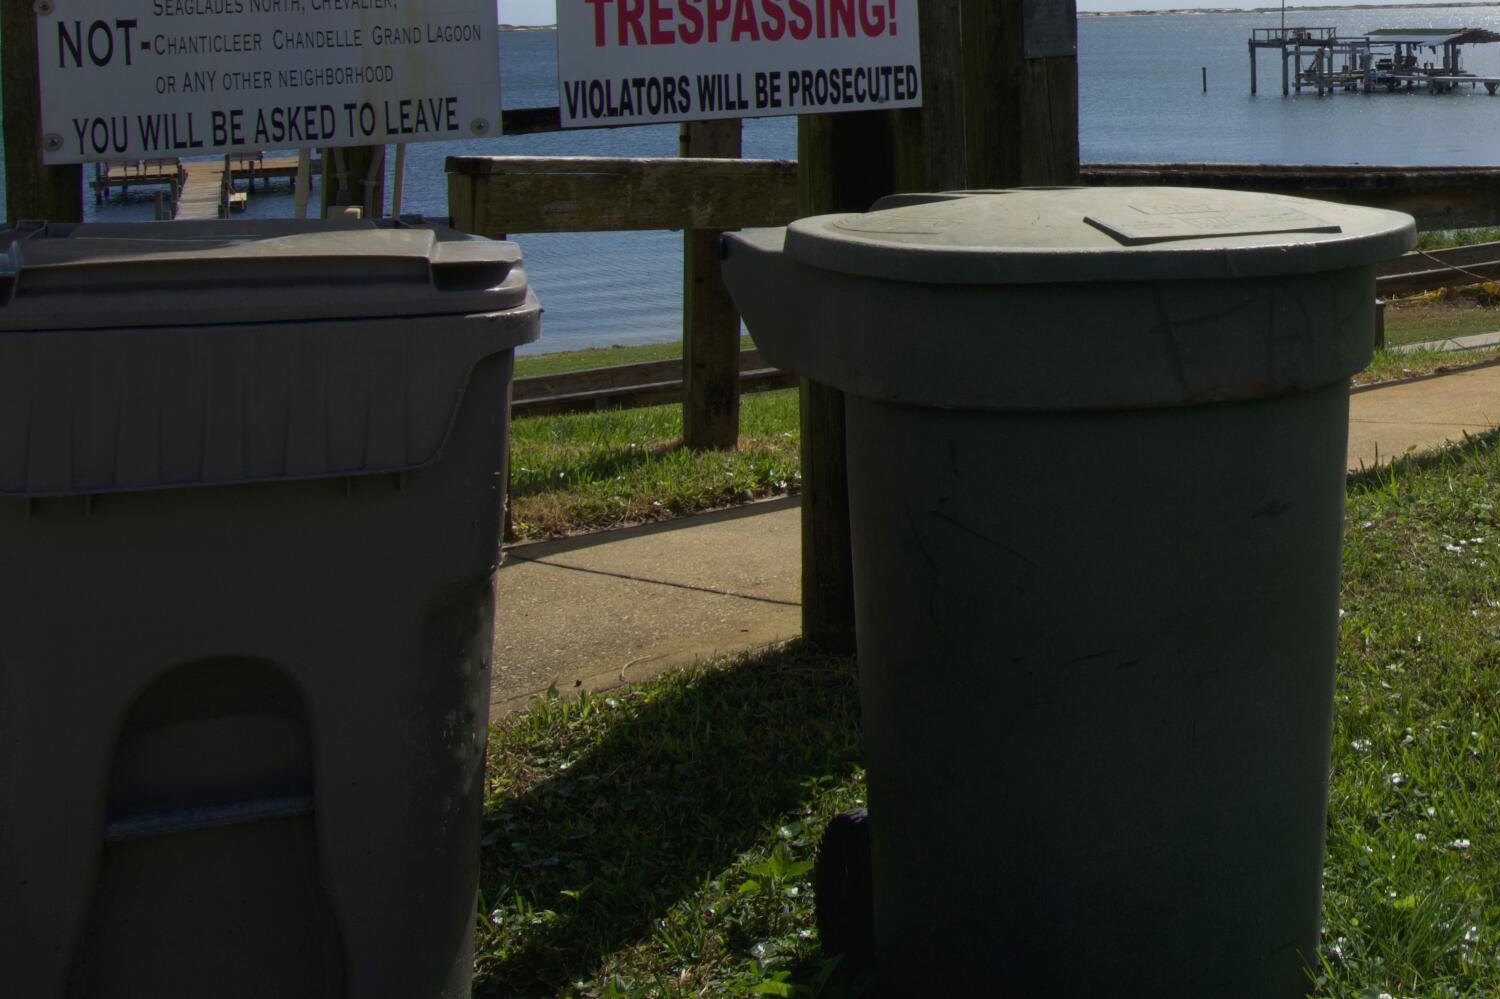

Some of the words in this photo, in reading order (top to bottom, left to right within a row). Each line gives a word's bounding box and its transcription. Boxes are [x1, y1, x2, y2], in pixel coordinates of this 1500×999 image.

[154, 33, 262, 55] CHANTICLEER
[272, 29, 362, 50] CHANDELLE
[372, 25, 422, 46] GRAND
[427, 23, 482, 43] LAGOON
[156, 76, 176, 94] OR
[182, 71, 216, 93] ANY
[222, 70, 272, 90] OTHER
[278, 65, 394, 88] NEIGHBORHOOD
[564, 75, 691, 119] VIOLATORS
[697, 73, 748, 112] WILL
[755, 71, 782, 108] BE
[788, 64, 919, 105] PROSECUTED
[72, 116, 129, 155] YOU
[137, 112, 203, 151] WILL
[211, 108, 245, 146] BE
[254, 104, 336, 144] ASKED
[343, 102, 376, 137] TO
[385, 96, 460, 136] LEAVE
